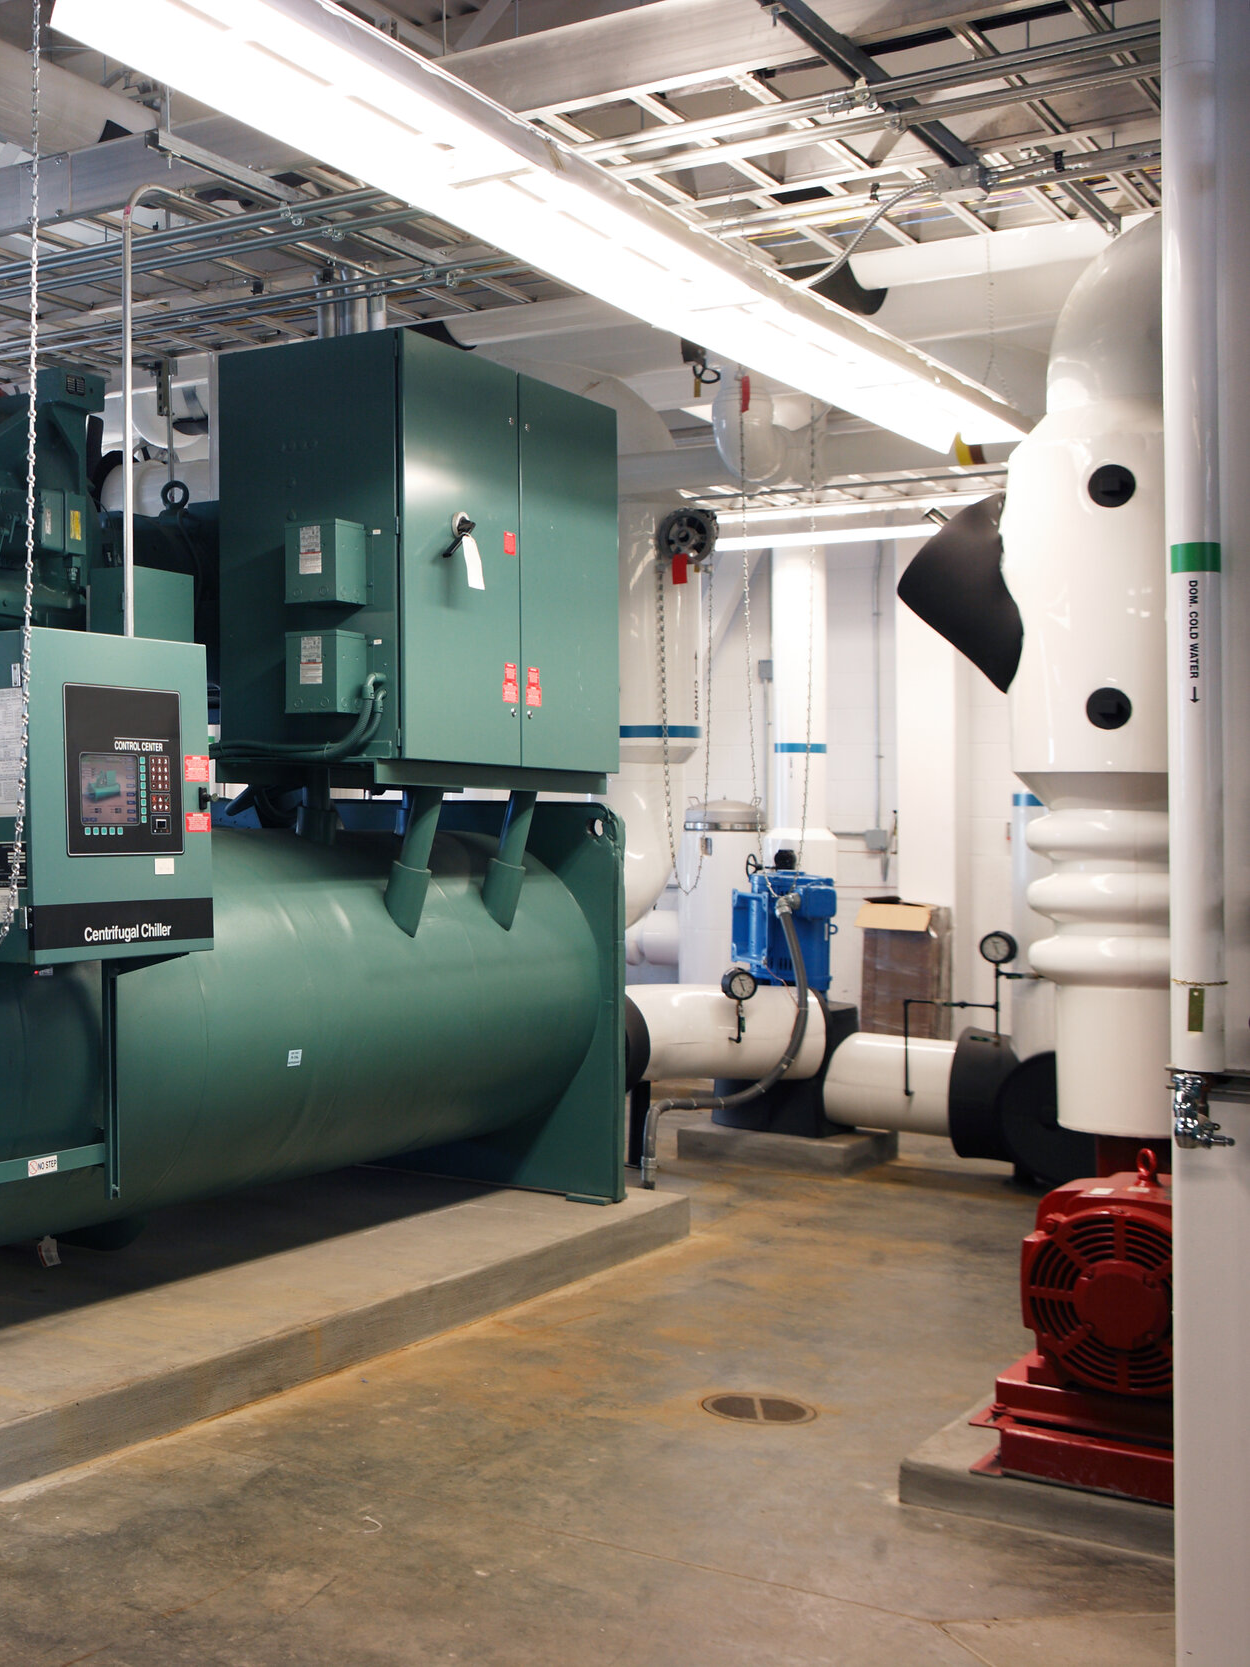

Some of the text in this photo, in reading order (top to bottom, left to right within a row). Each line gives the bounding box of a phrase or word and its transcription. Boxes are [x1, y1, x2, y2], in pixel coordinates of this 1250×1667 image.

[1189, 580, 1199, 678] DOM. COLD WATER
[114, 741, 163, 752] CONTROL CENTER
[84, 923, 171, 942] Centrifugal Chiller
[37, 1159, 57, 1170] NO STEP
